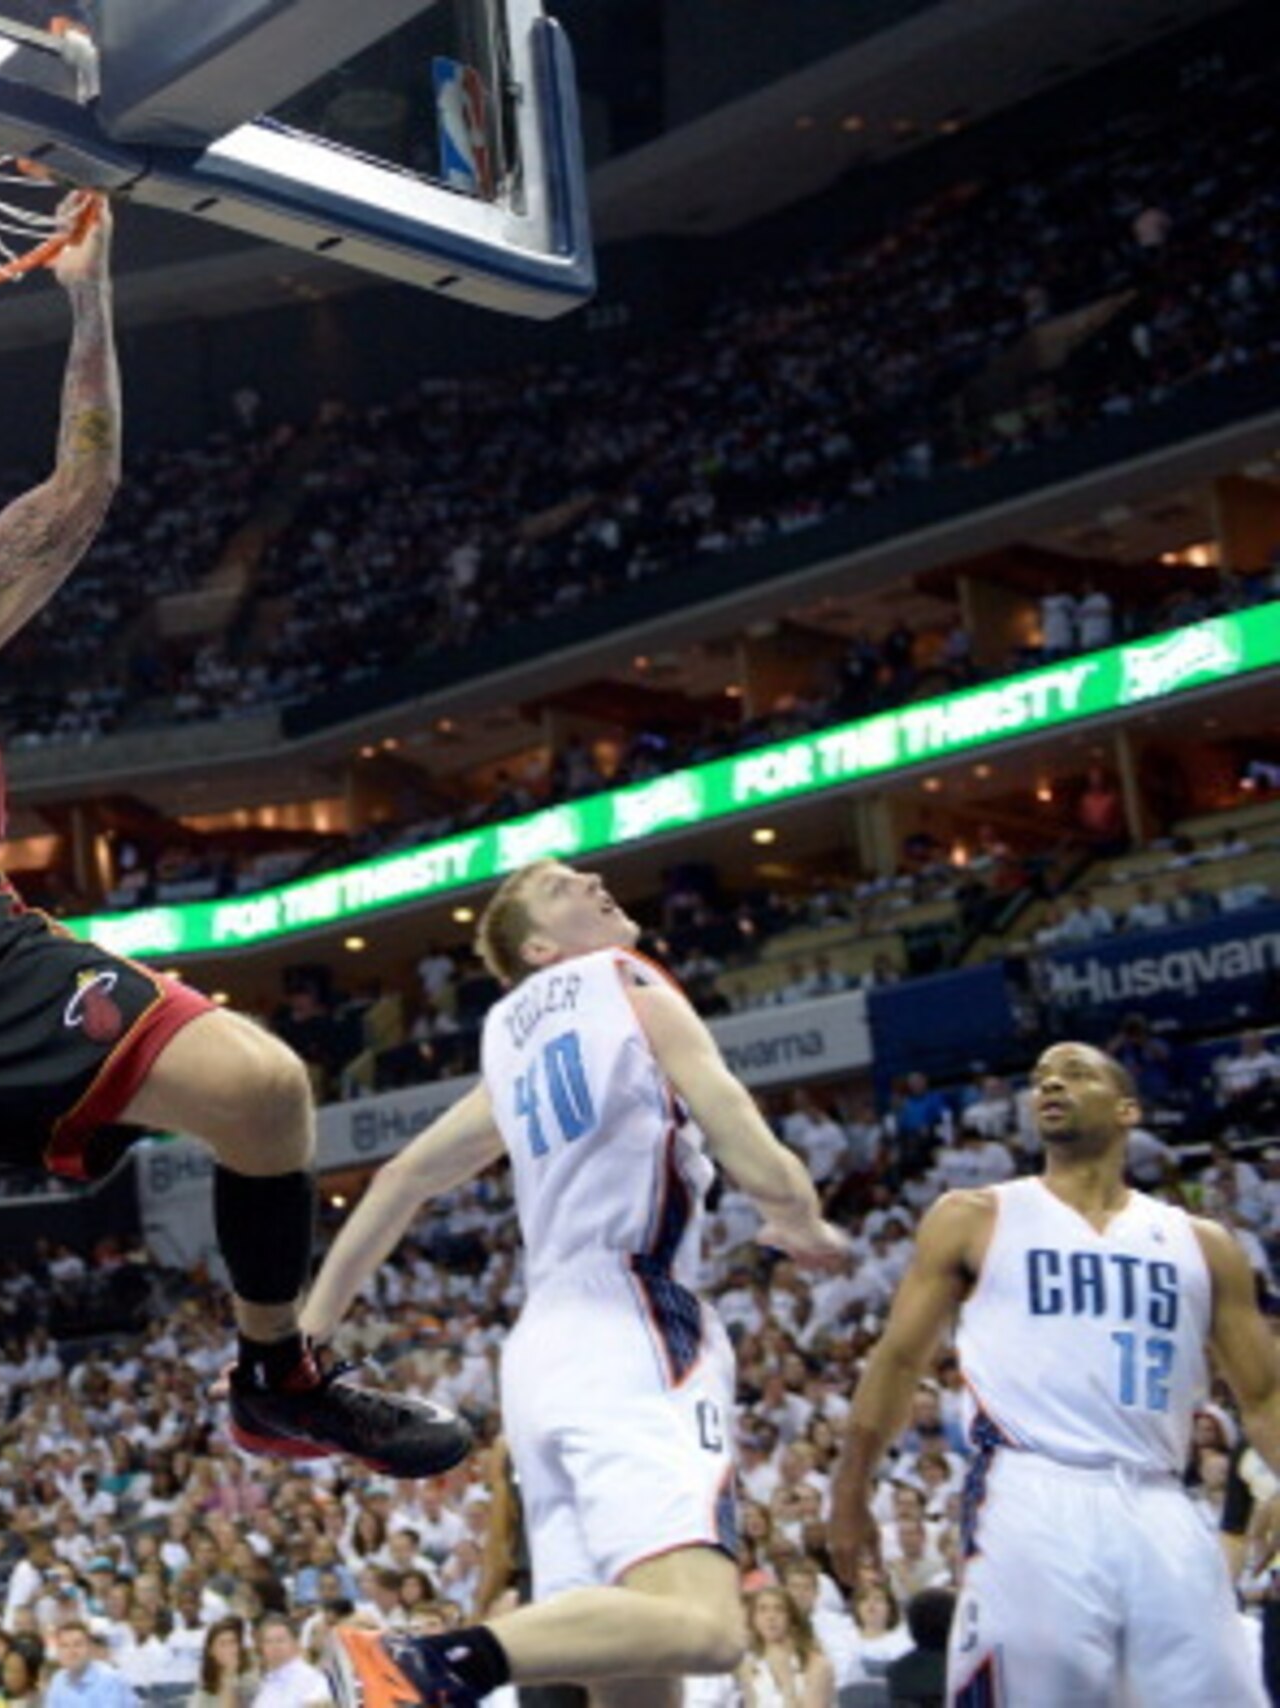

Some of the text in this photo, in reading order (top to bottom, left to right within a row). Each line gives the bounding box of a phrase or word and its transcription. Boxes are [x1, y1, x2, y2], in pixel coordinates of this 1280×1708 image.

[733, 662, 1099, 802] FOR THE THIRSTY
[211, 894, 280, 942] FOR
[280, 873, 341, 925] THE
[339, 836, 483, 910] THIRSTY
[514, 1028, 597, 1159] 40
[1027, 1249, 1178, 1331] CATS
[1110, 1331, 1174, 1411] 12
